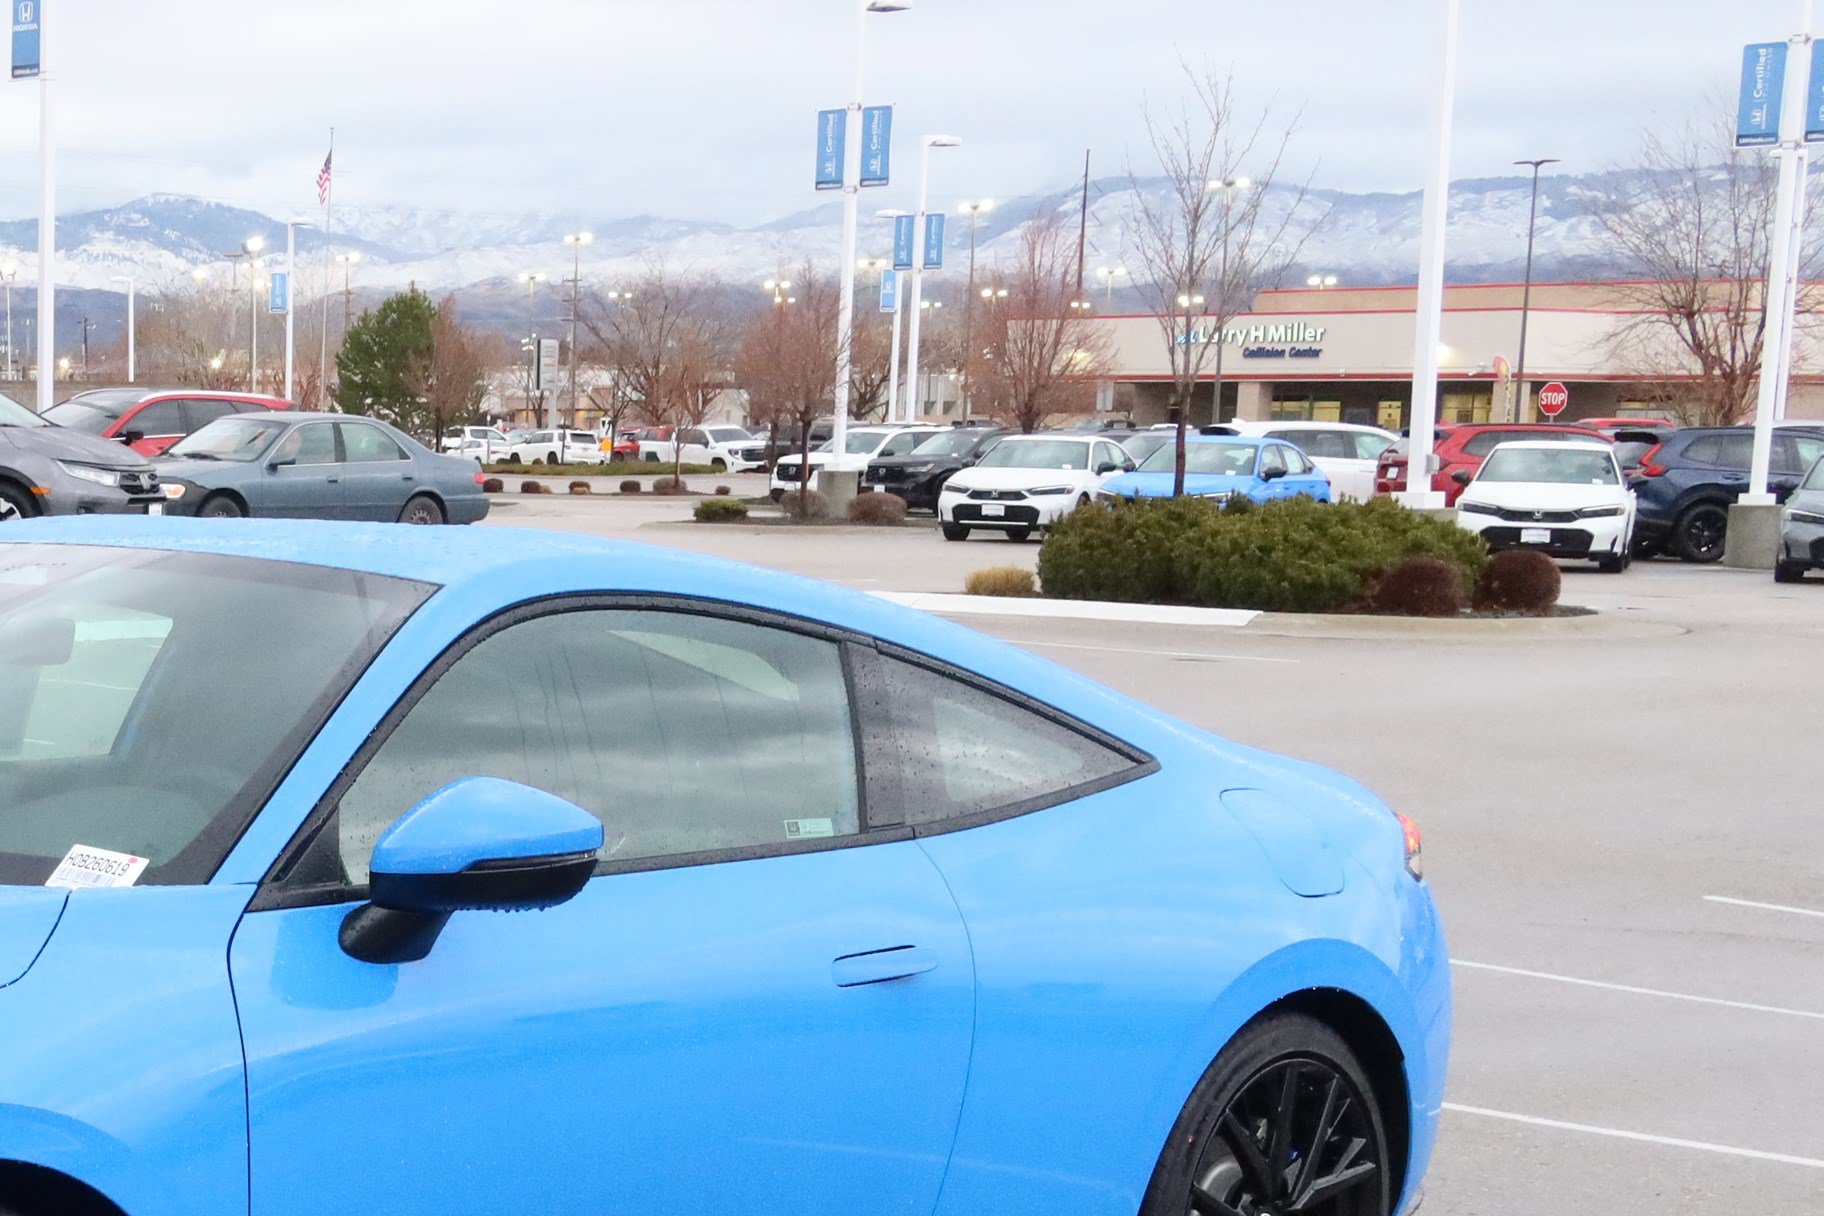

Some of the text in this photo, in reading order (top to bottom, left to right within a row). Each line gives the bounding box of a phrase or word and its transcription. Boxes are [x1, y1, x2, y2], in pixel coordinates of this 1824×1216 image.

[1753, 48, 1767, 98] Certified
[1250, 325, 1265, 343] H
[1268, 321, 1326, 343] Miller
[1540, 392, 1566, 406] STOP
